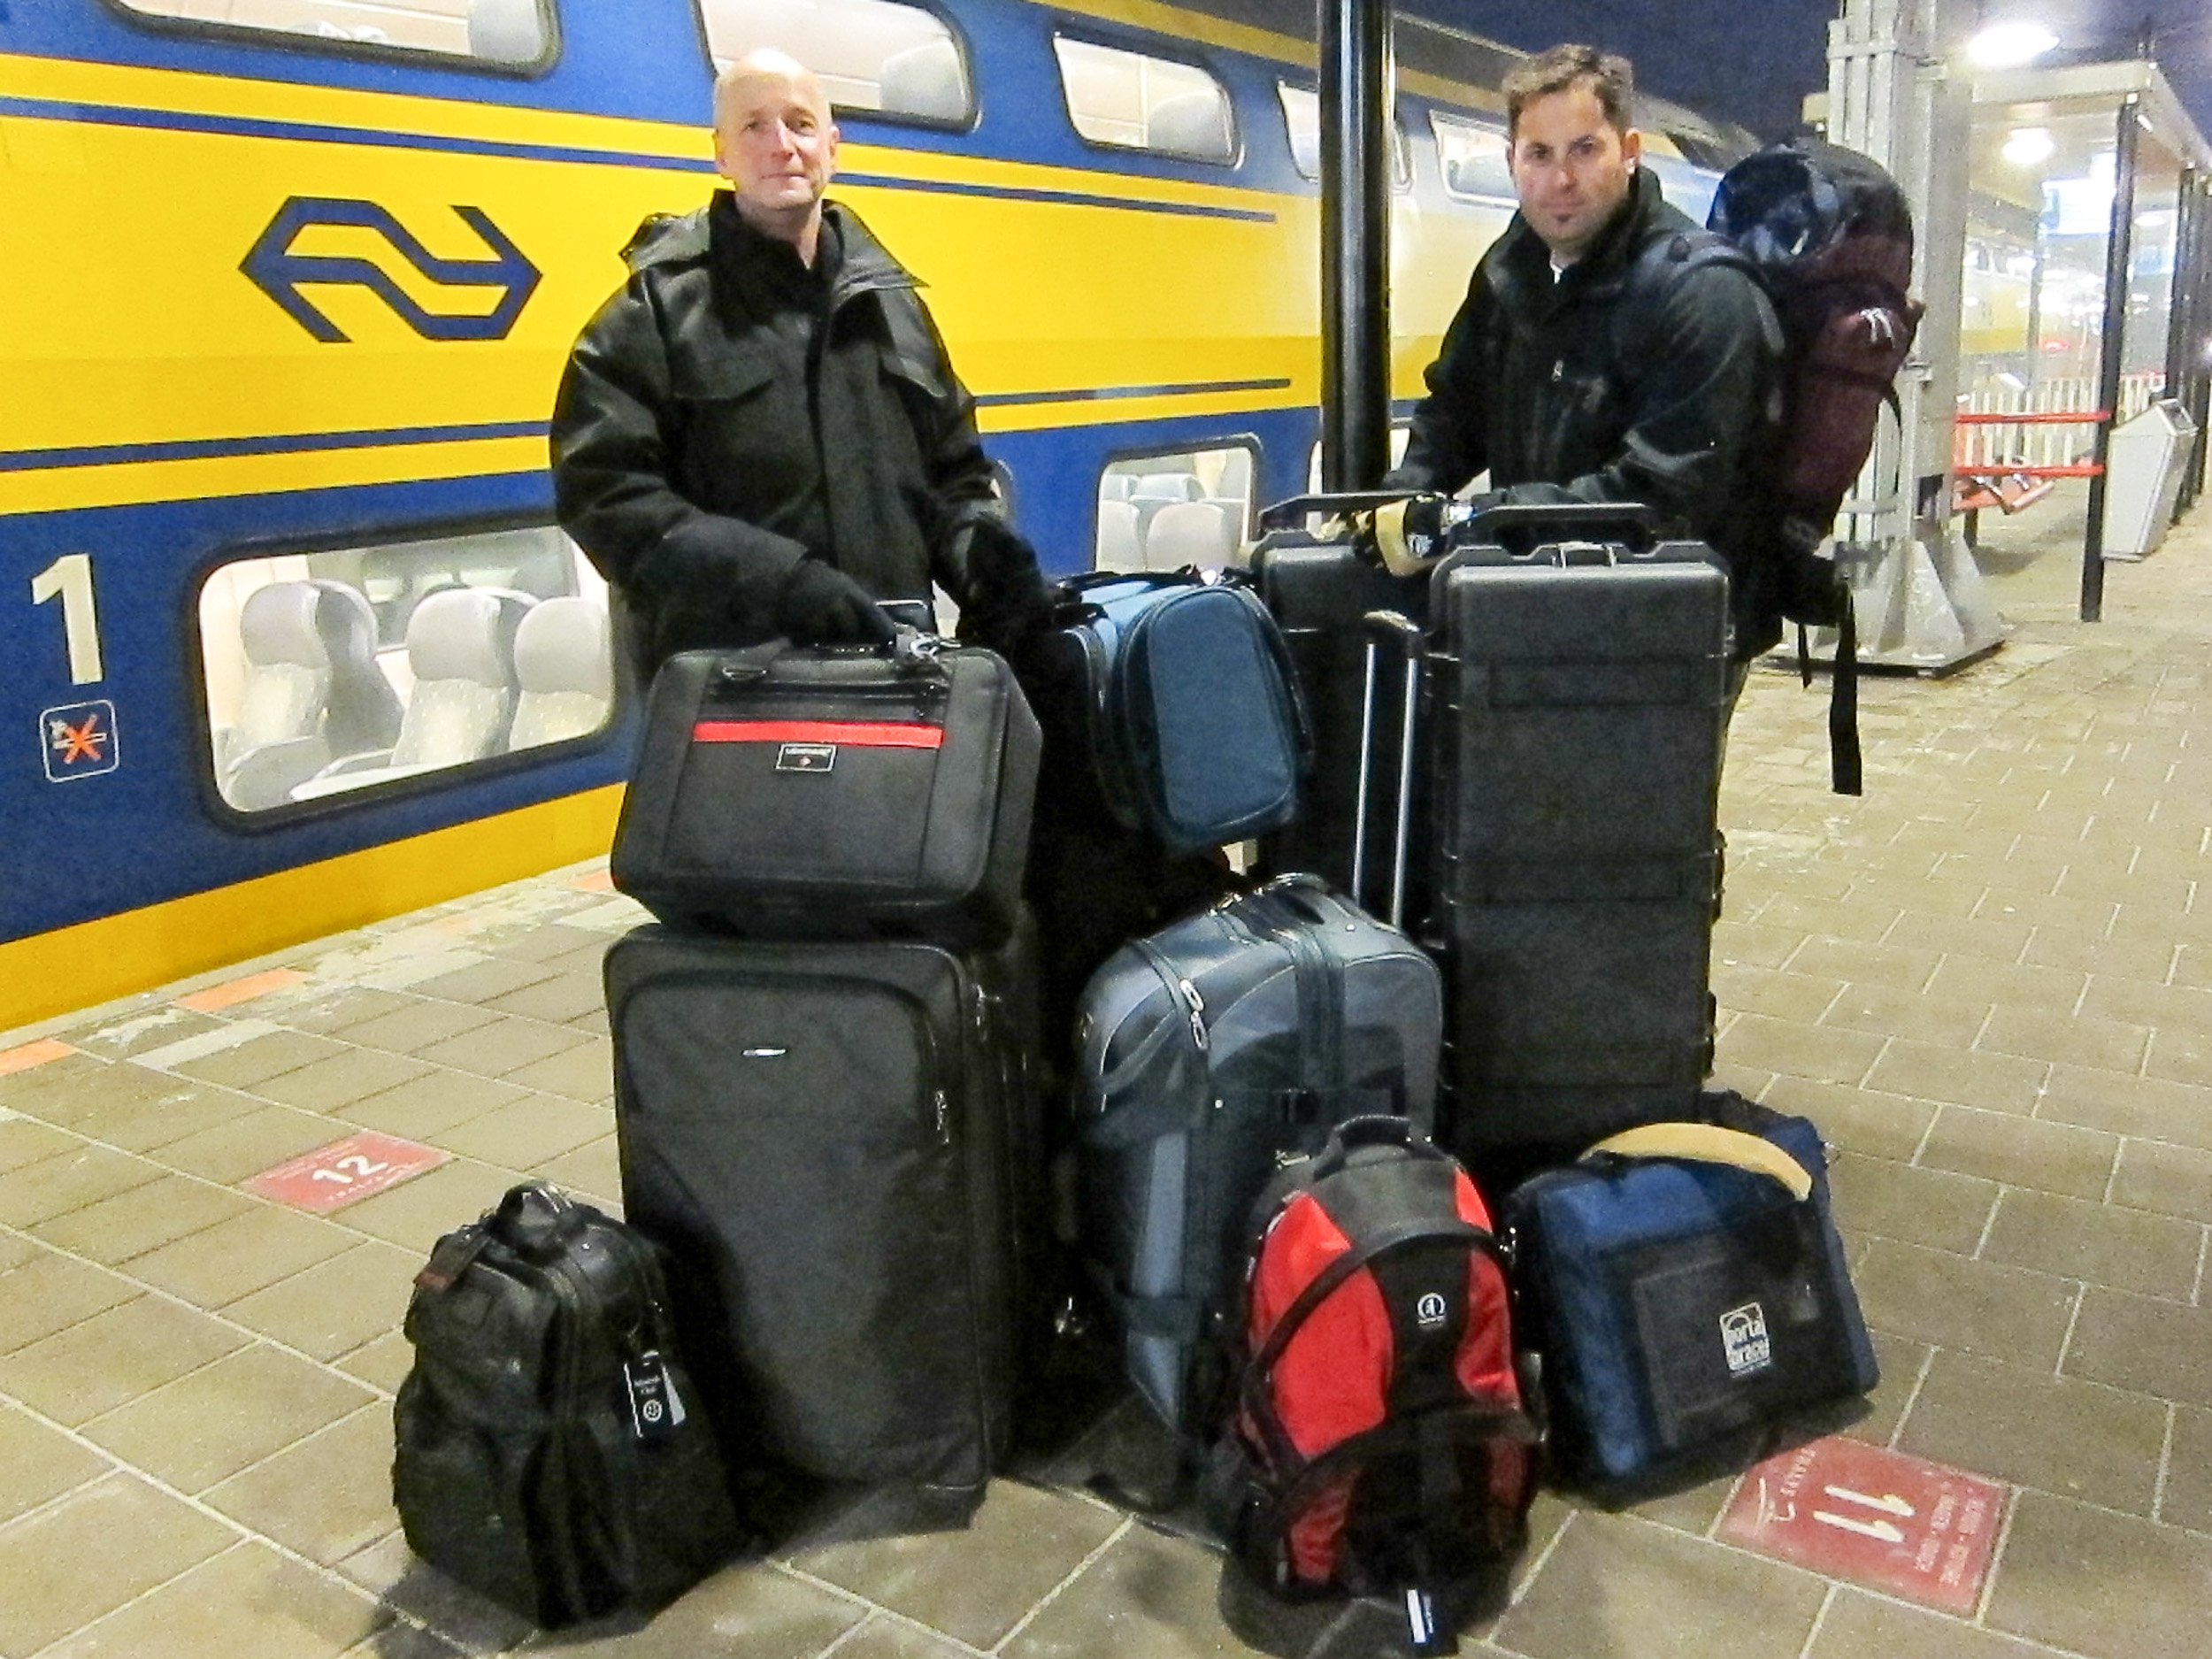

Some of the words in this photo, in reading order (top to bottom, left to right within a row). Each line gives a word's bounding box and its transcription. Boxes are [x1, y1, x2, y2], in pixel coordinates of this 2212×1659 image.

[31, 552, 104, 686] 1
[311, 1155, 389, 1184] 12
[1812, 1484, 1916, 1543] 11
